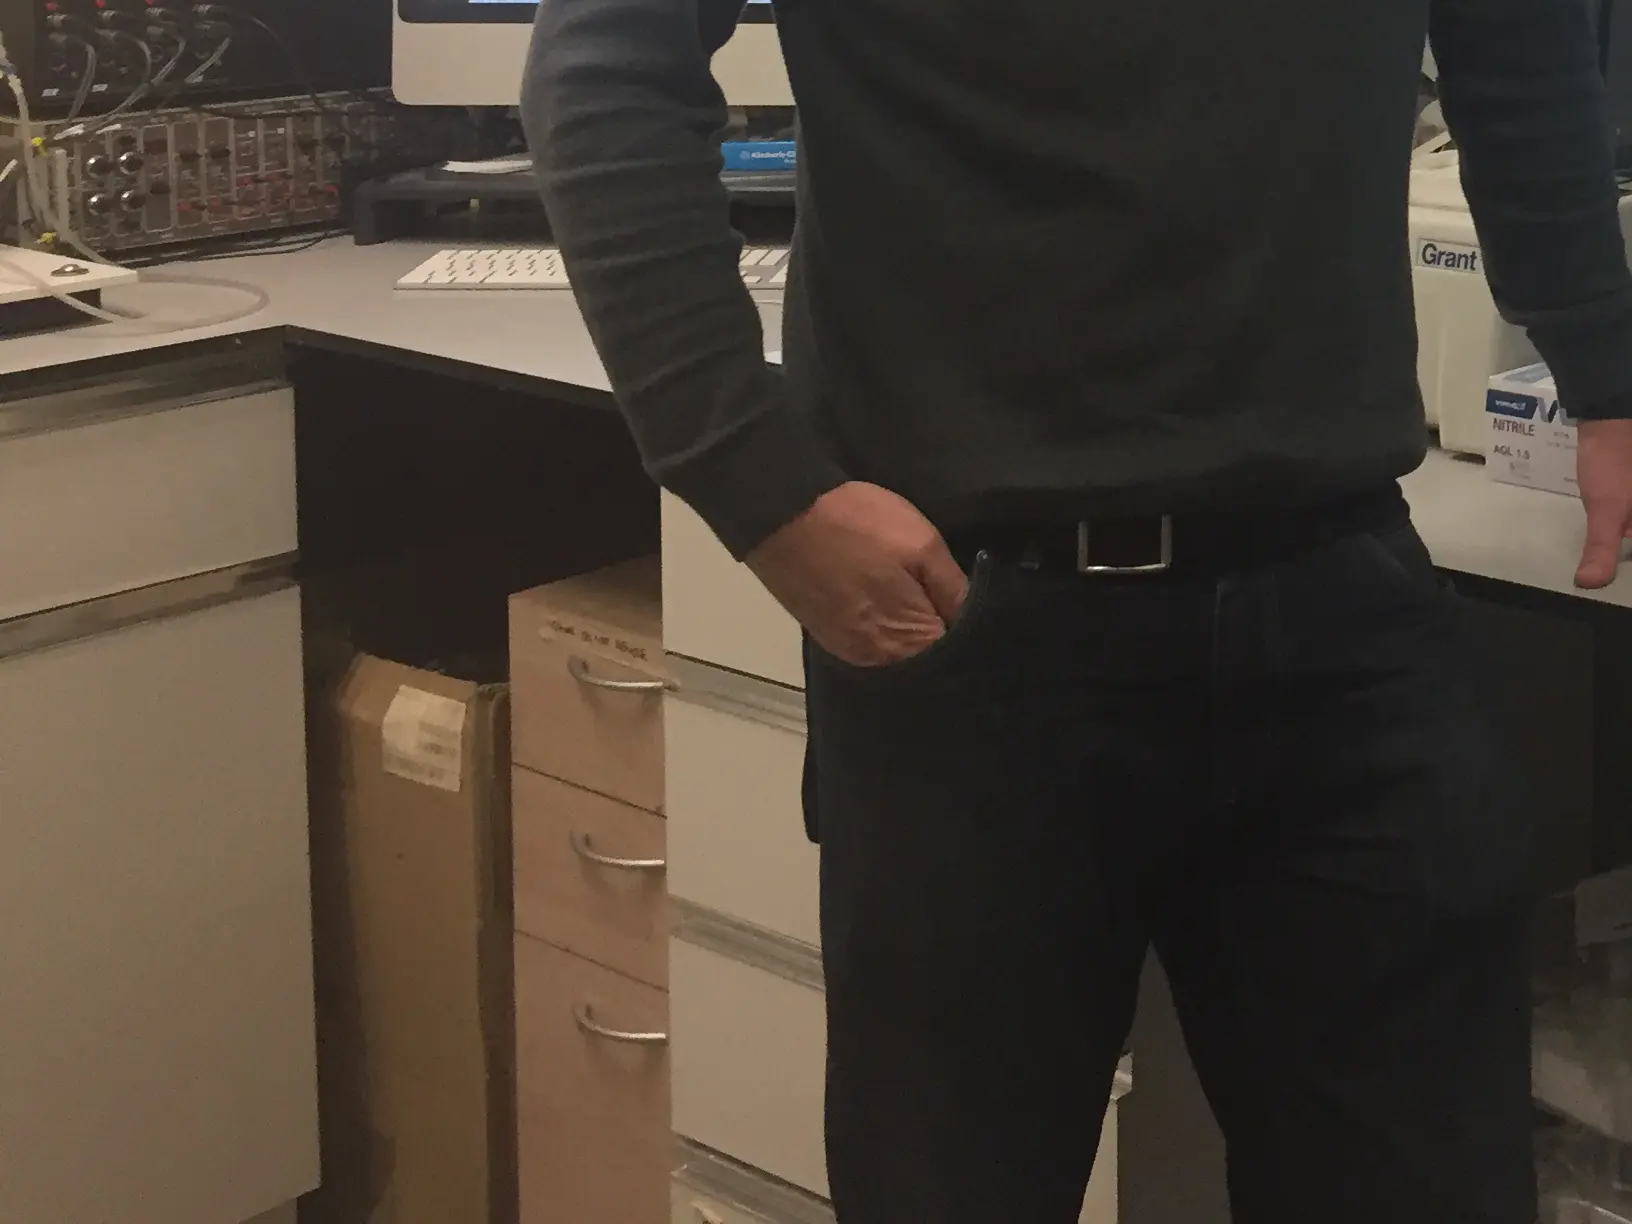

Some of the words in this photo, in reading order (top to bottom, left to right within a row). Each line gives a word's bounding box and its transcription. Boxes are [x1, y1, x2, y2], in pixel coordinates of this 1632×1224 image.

[1421, 243, 1478, 271] Grant
[1493, 417, 1535, 436] NITRILE
[1493, 445, 1513, 456] AQL
